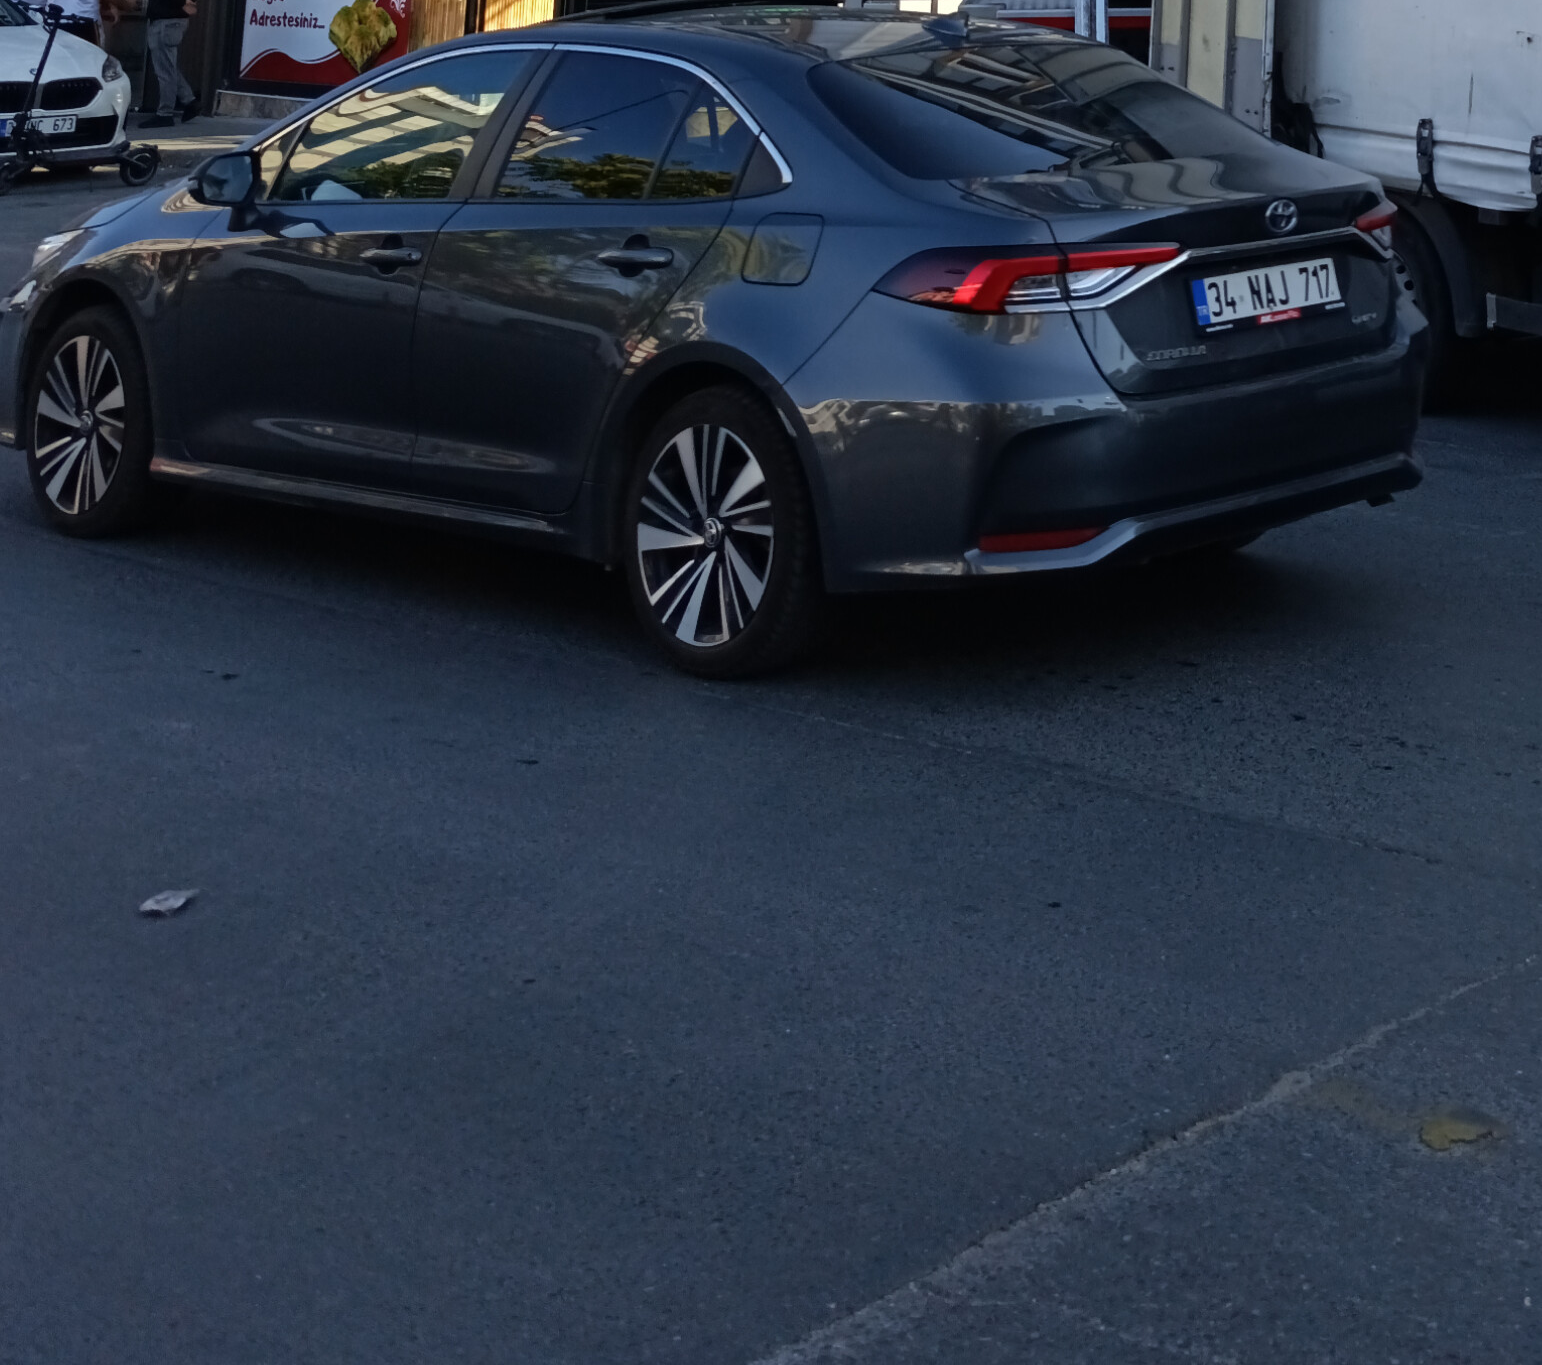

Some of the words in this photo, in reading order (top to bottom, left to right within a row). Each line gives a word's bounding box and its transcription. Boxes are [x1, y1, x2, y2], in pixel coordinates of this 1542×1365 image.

[53, 117, 74, 131] 673
[1207, 279, 1236, 317] 34
[1247, 271, 1289, 310] NAJ
[1298, 264, 1329, 302] 717
